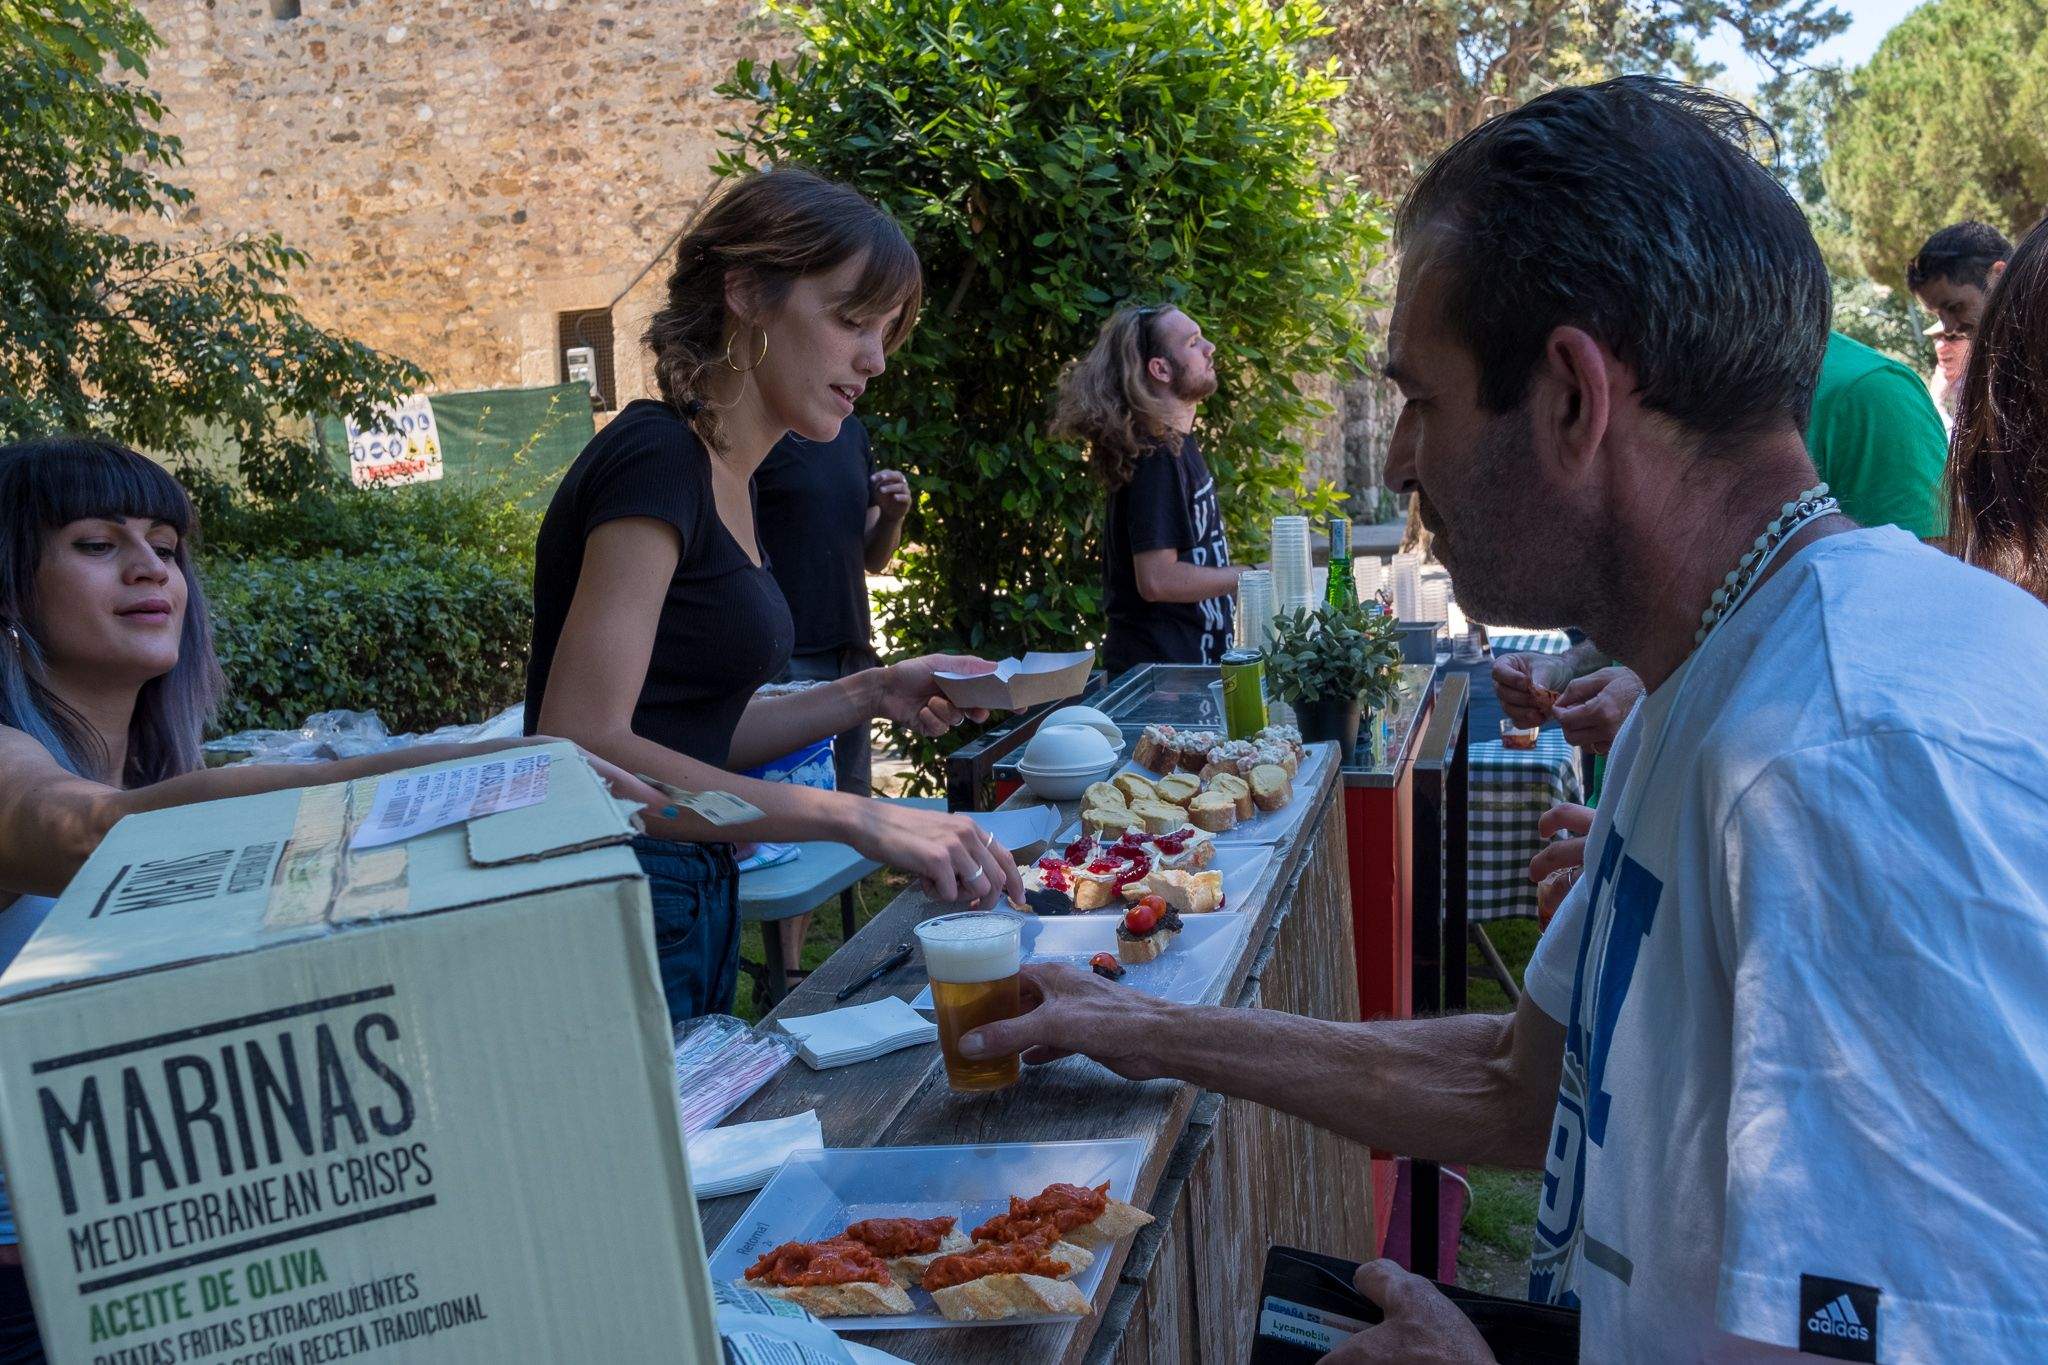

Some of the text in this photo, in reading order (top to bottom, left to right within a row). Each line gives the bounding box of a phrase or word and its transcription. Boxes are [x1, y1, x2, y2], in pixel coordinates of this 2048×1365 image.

[37, 1012, 417, 1215] MARINAS
[68, 1143, 433, 1273] MEDITERRANEAN CRISPS
[88, 1248, 328, 1343] ACEITE DE OLIVA
[178, 1317, 246, 1361] FRITAS
[249, 1273, 420, 1342] EXTRACRUJIENTES
[233, 1293, 488, 1365] GÚN RECETA TRADICIONAL
[1272, 1319, 1331, 1343] Lycamobile
[1807, 1317, 1871, 1341] adidas
